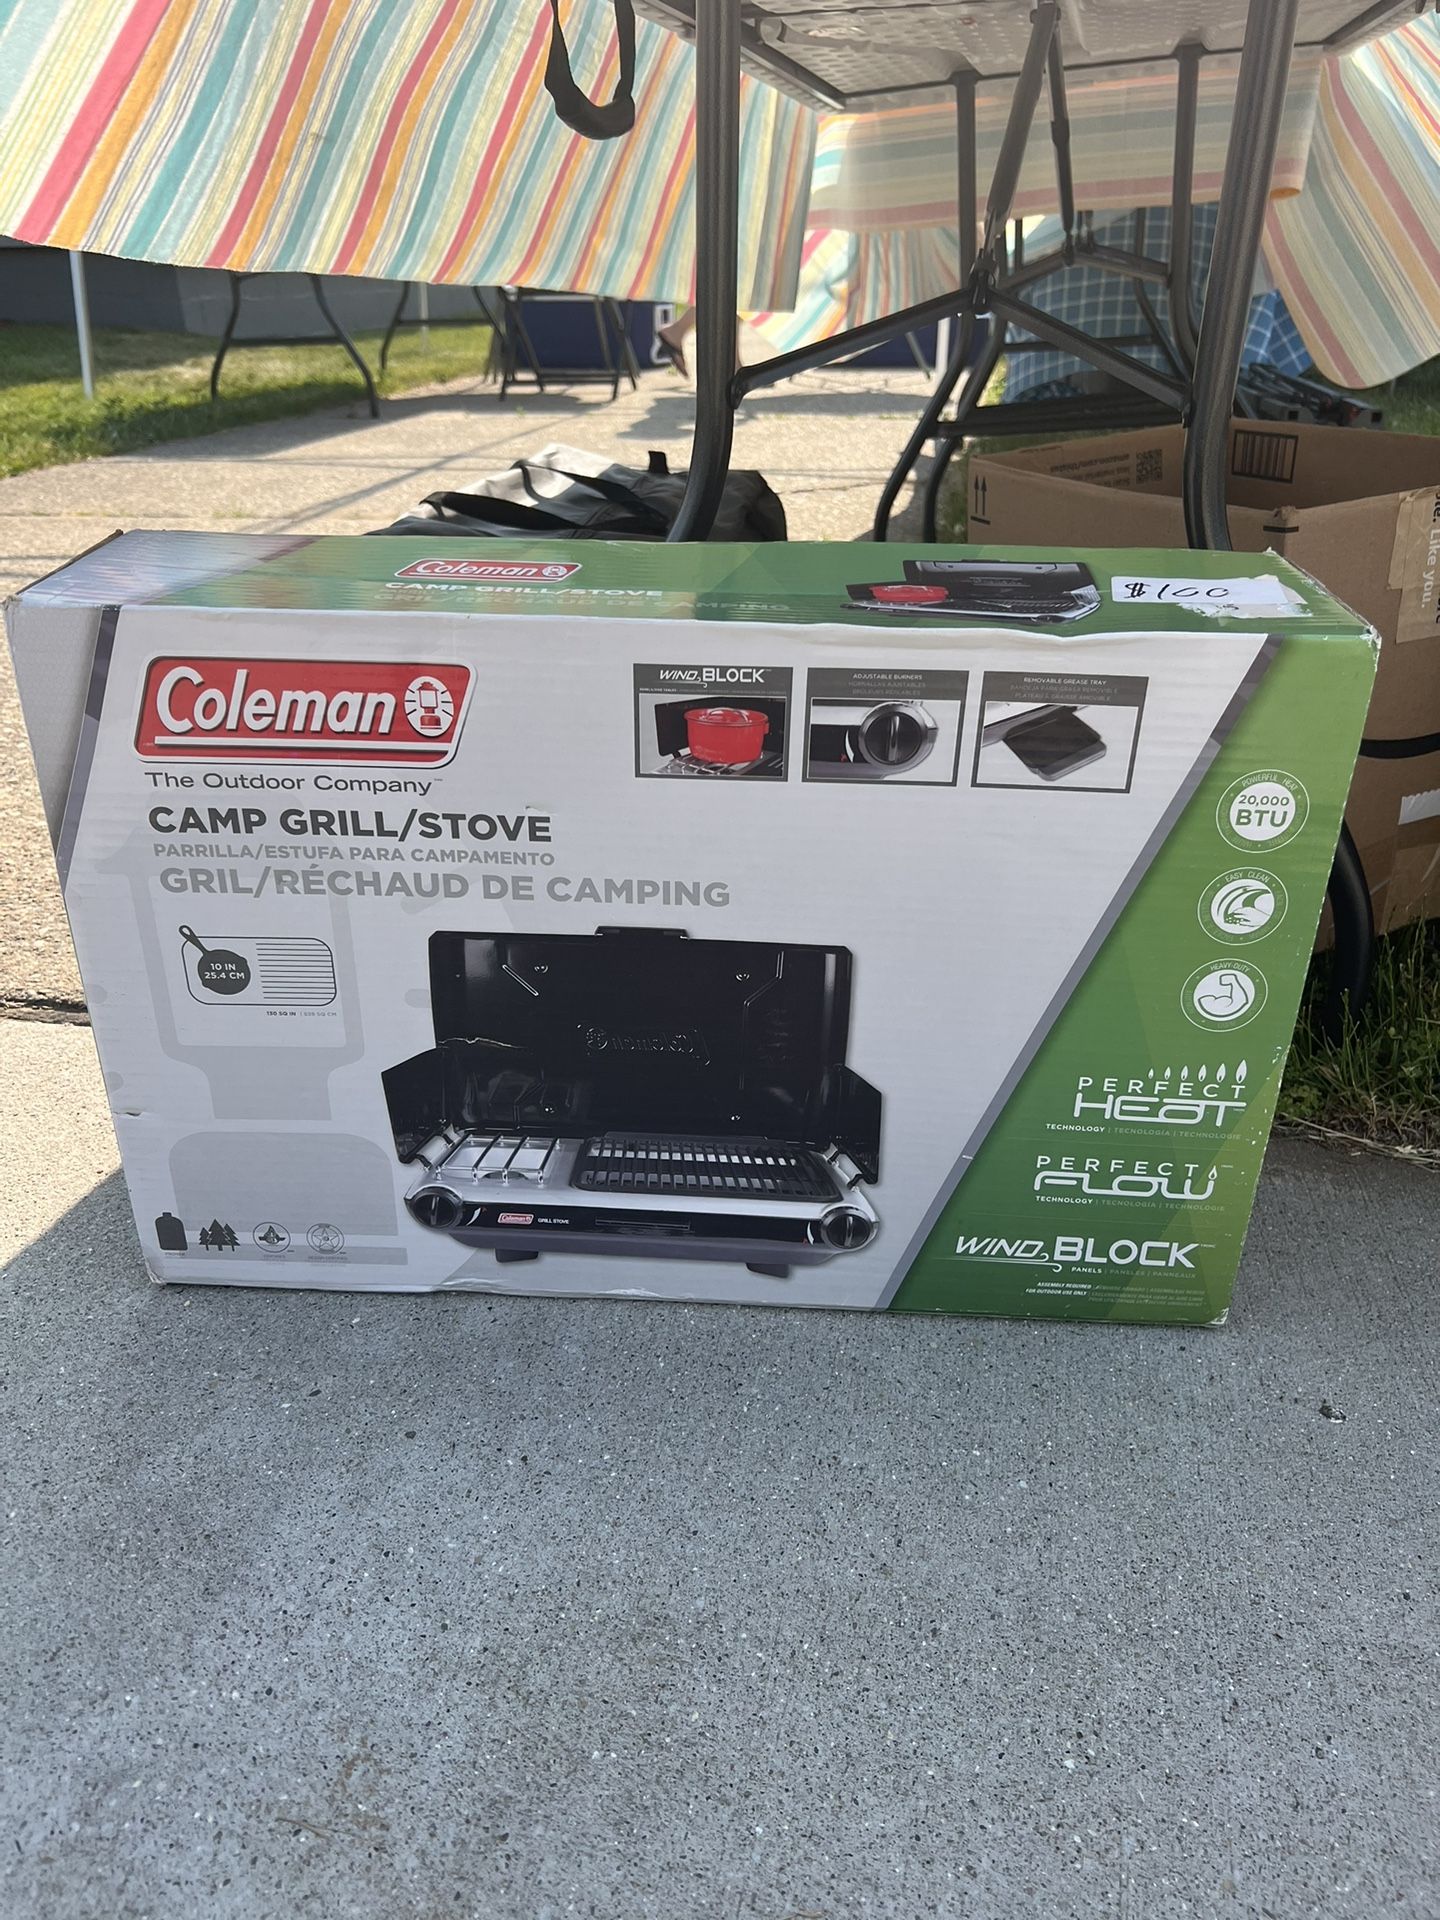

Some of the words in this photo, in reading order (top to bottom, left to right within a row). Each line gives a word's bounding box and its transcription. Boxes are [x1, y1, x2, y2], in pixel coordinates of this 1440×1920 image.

[415, 560, 538, 577] Coleman
[385, 582, 467, 592] CAMP
[474, 586, 663, 597] GRILL/STOVE
[1124, 582, 1230, 601] $100
[1421, 568, 1435, 609] you.
[659, 669, 698, 681] WIND
[702, 667, 765, 683] BLOCK
[1023, 676, 1062, 684] REMOVABLE
[156, 665, 397, 734] Coleman
[144, 771, 195, 788] The
[202, 772, 306, 791] Outdoor
[313, 774, 432, 796] Company
[1241, 773, 1279, 787] POWERFUL
[1282, 777, 1299, 792] HEAT
[1238, 794, 1290, 807] 20,000
[149, 806, 268, 835] CAMP
[280, 808, 552, 843] GRILL/STOVE
[1235, 808, 1288, 828] BTU
[153, 843, 344, 860] PARRILLA/ESTUFA
[350, 846, 406, 862] PARA
[411, 848, 555, 866] CAMPAMENTO
[159, 863, 470, 899] GRIL/RÉCHAUD
[482, 873, 535, 901] DE
[546, 876, 730, 907] CAMPING
[1224, 871, 1244, 883] EASY
[1247, 870, 1271, 883] CLEAN
[204, 971, 227, 980] 25.4
[229, 971, 245, 980] CM
[210, 962, 222, 971] 10
[224, 963, 236, 971] IN
[1077, 1076, 1246, 1099] PERFECT
[1045, 1122, 1105, 1133] TECHNOLOGY
[1036, 1155, 1199, 1178] PERFECT
[1033, 1170, 1215, 1201] FLOW
[1035, 1195, 1094, 1205] TECHNOLOGY
[954, 1235, 1045, 1258] WIND
[1053, 1235, 1200, 1269] BLOCK
[1071, 1266, 1103, 1274] PANELS
[1037, 1281, 1065, 1289] ASSEMBLY
[1066, 1282, 1092, 1290] REQUIRED
